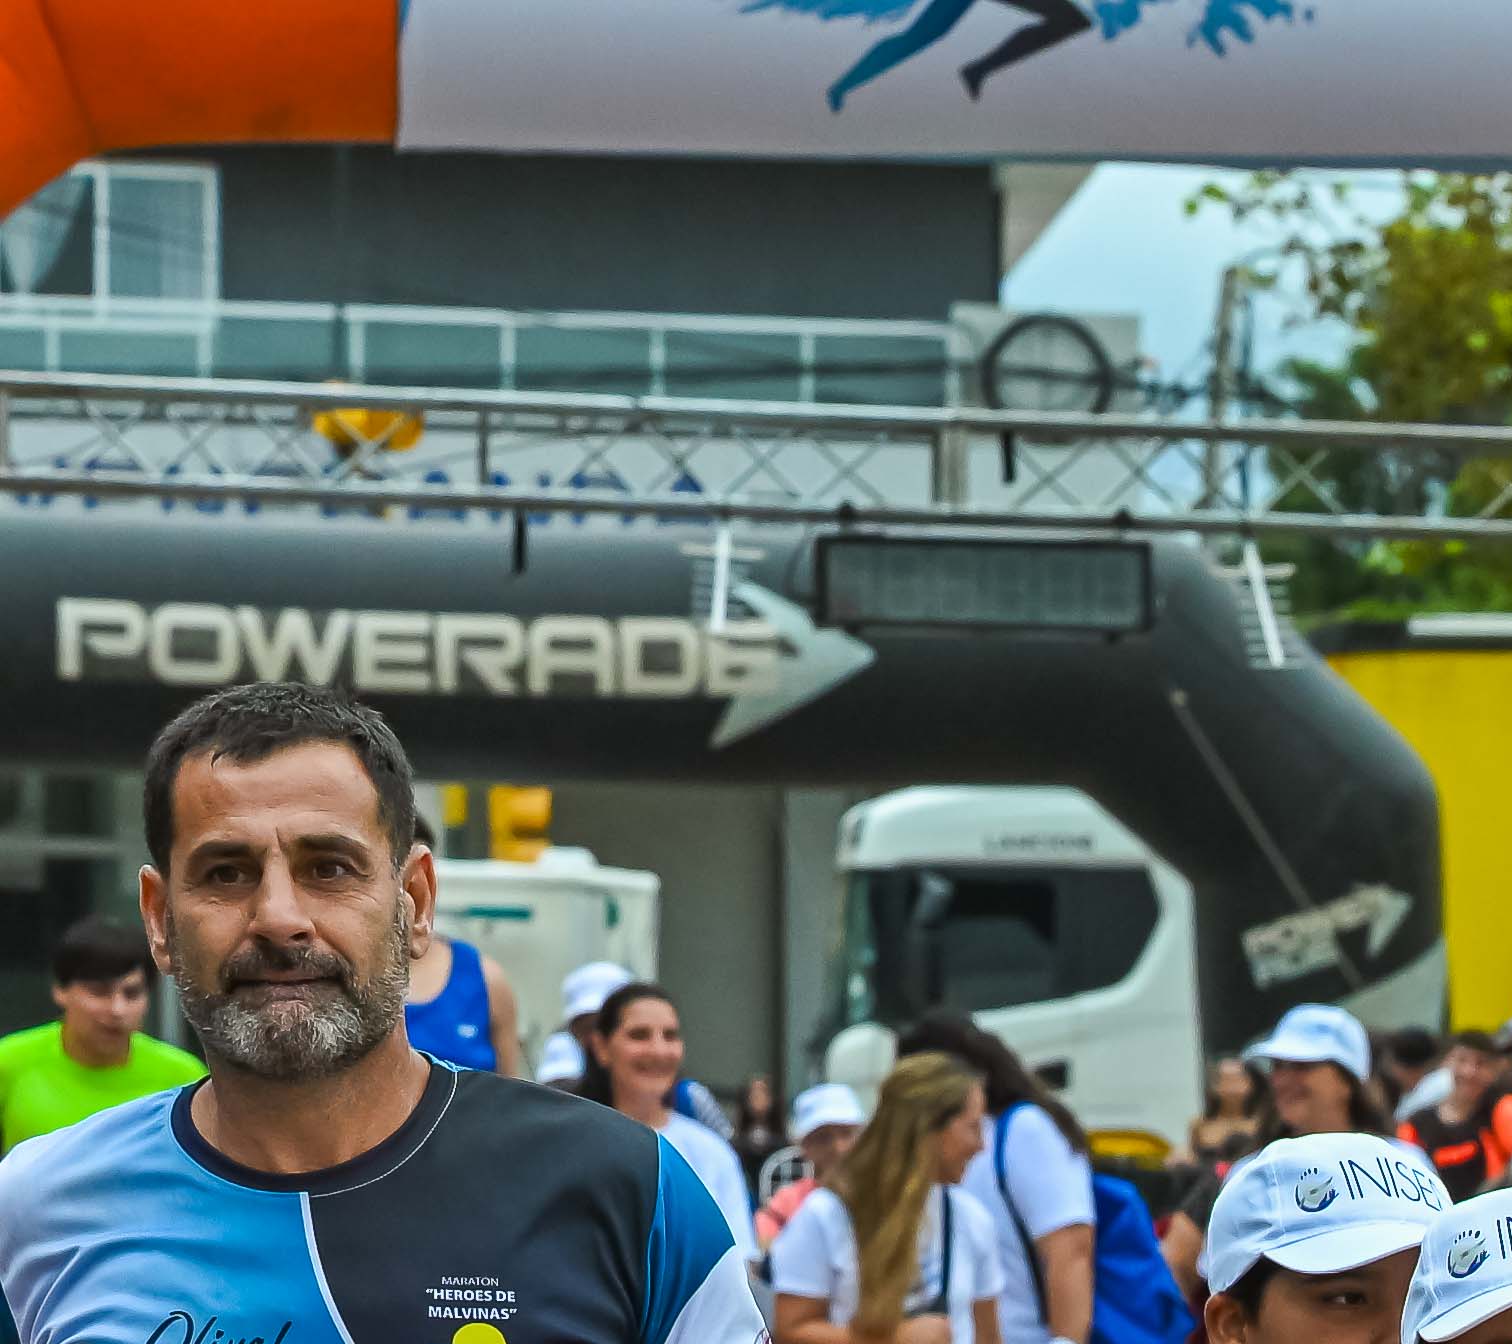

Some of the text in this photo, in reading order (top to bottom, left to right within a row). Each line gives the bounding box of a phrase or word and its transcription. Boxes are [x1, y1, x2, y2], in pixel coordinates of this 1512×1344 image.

[55, 597, 782, 699] POWERADE
[441, 1276, 500, 1287] MARATON
[495, 1290, 517, 1303] DE
